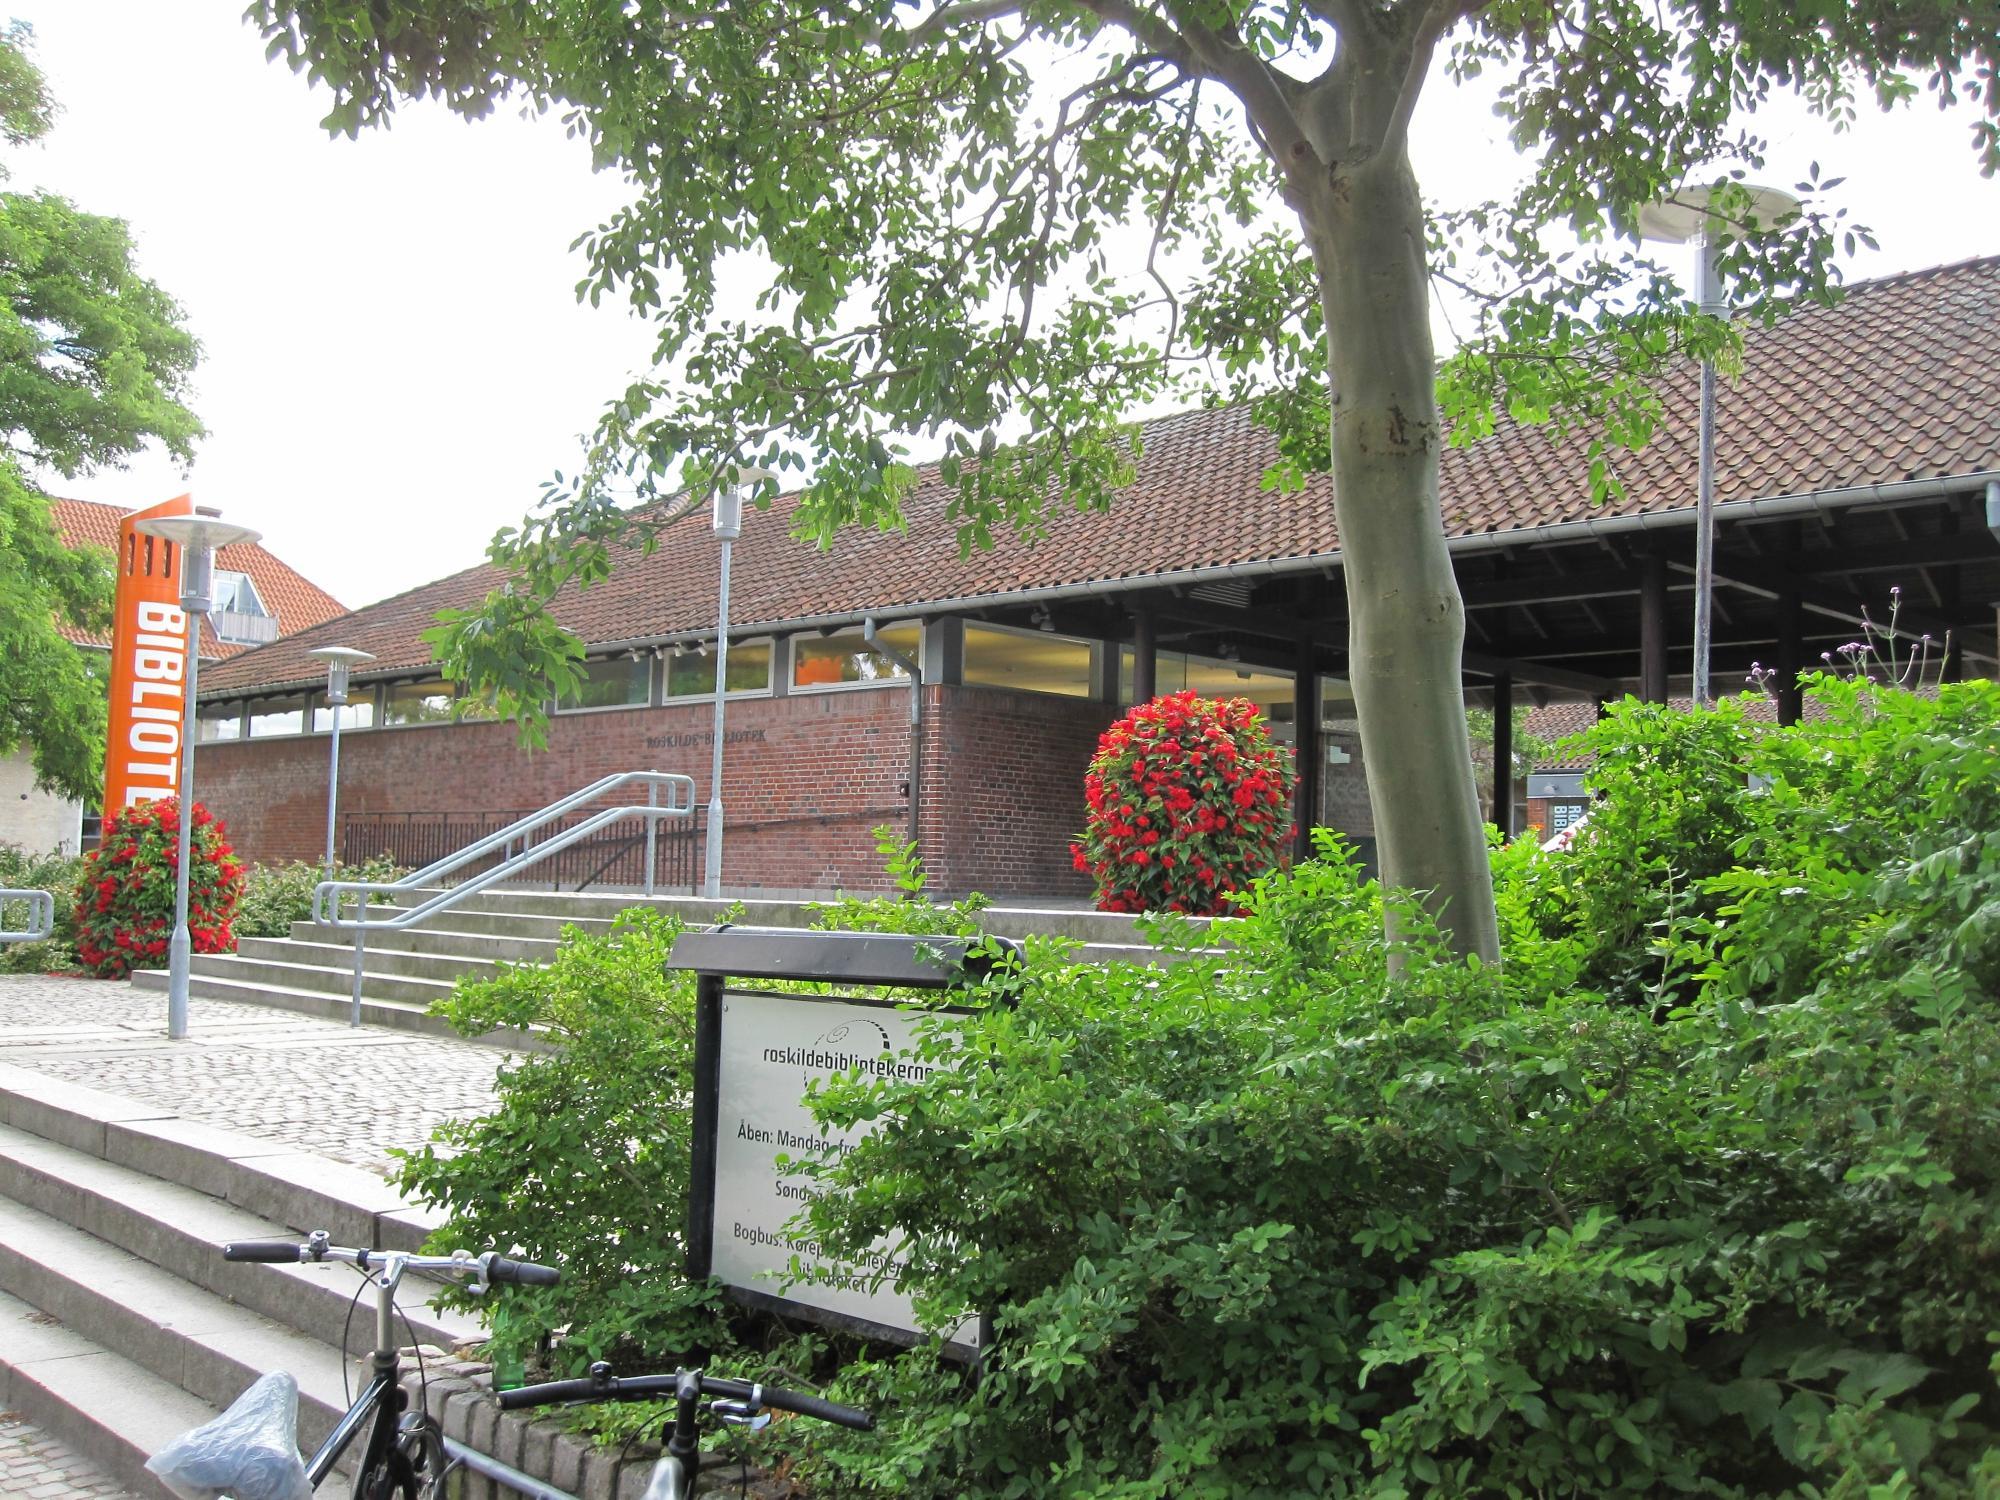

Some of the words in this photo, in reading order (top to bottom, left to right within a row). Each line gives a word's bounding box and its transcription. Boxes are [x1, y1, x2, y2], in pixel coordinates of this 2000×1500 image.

[125, 601, 186, 807] BIBLIOTE
[1568, 805, 1582, 824] RO
[737, 1119, 773, 1144] Åben:
[734, 1222, 783, 1246] Bogbus:
